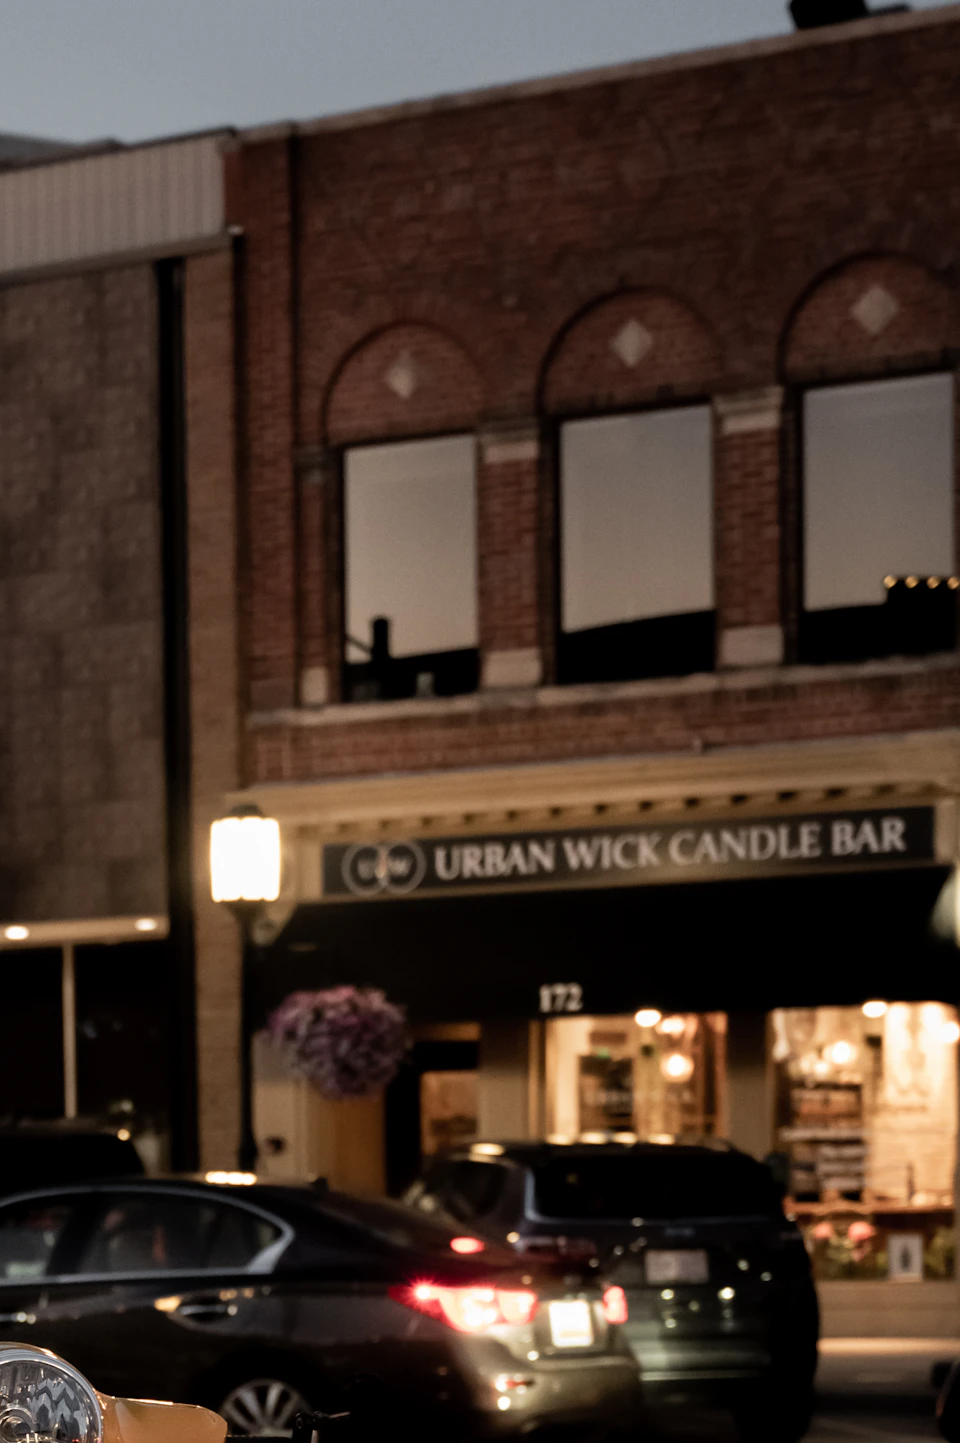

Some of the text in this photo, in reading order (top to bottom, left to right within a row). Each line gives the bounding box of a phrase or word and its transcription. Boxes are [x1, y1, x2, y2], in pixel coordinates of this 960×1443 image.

[435, 818, 905, 880] URBAN WICK CANDLE BAR
[539, 983, 583, 1012] 172
